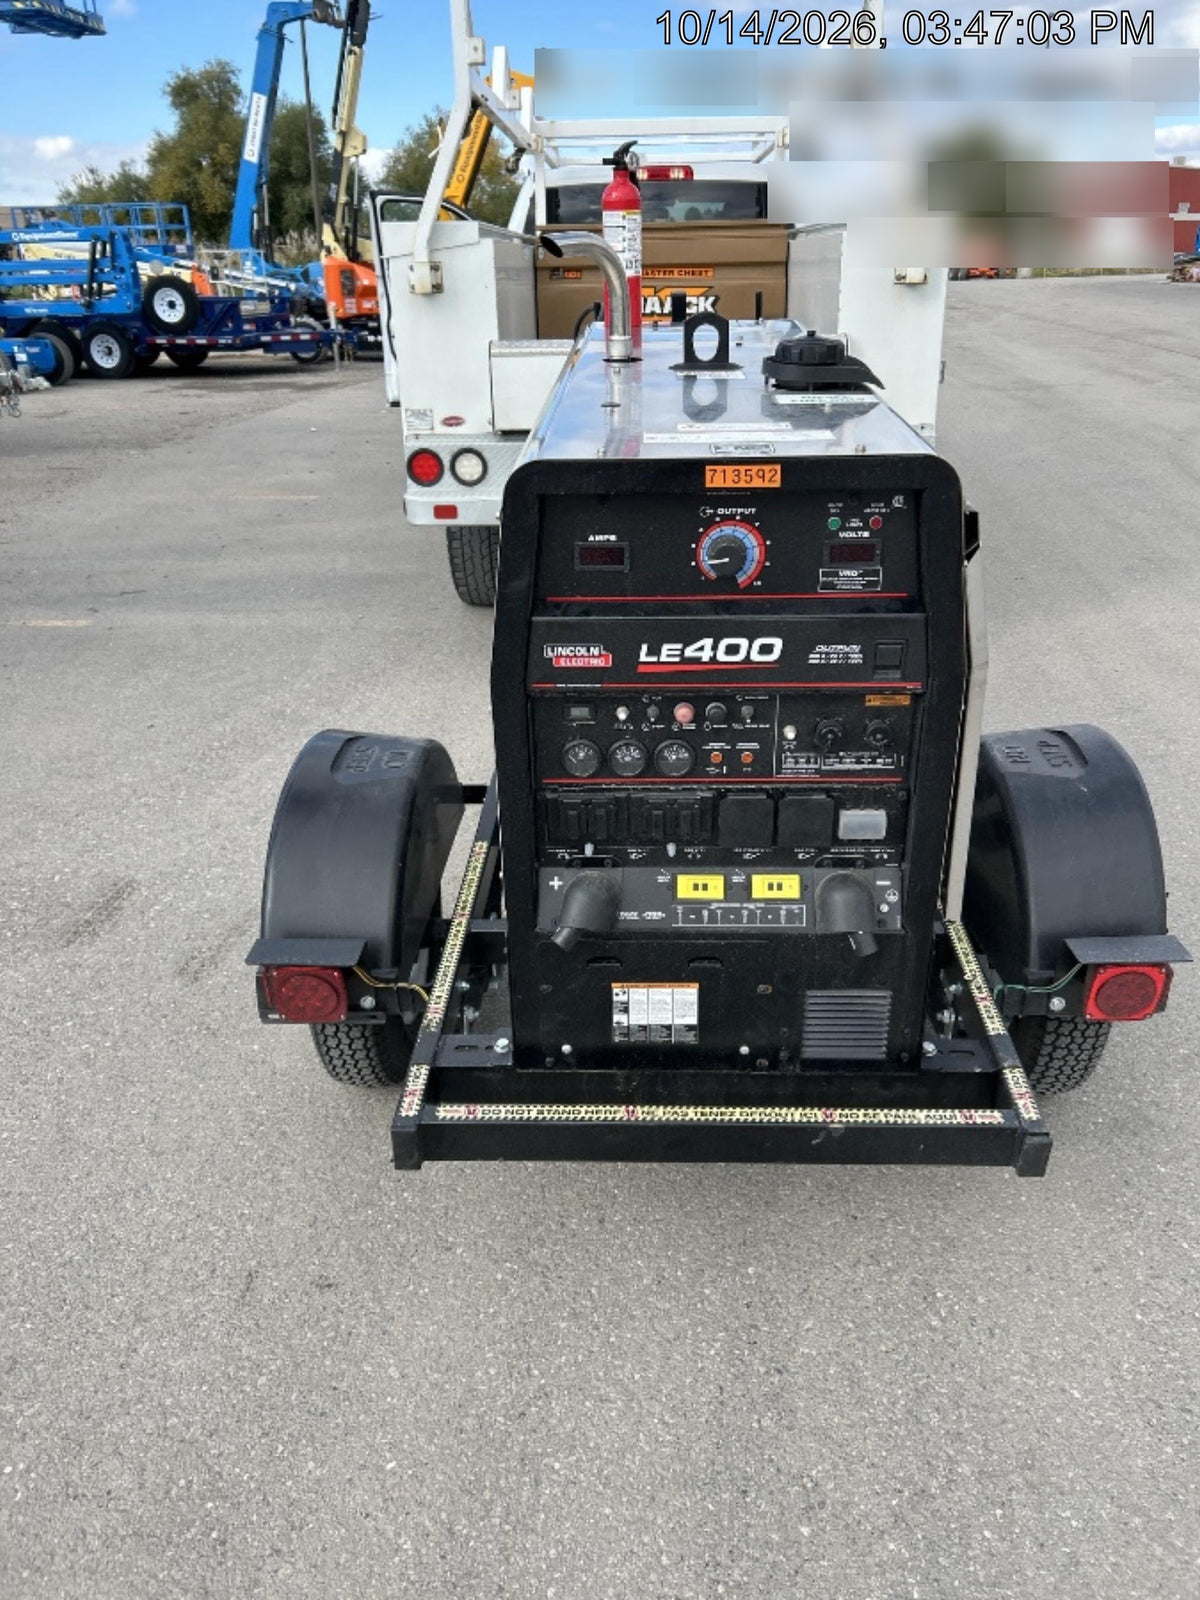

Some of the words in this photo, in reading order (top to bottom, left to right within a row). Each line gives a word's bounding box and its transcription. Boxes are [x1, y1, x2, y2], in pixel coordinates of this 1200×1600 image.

[708, 467, 778, 484] 713592
[717, 507, 757, 515] OUTPUT
[588, 534, 617, 542] AMPS
[838, 530, 870, 538] VOLTS
[546, 646, 600, 657] LINCOLN
[638, 637, 784, 662] LE400
[481, 1108, 501, 1116] DO
[504, 1108, 533, 1116] NOT
[535, 1108, 582, 1116] STAND
